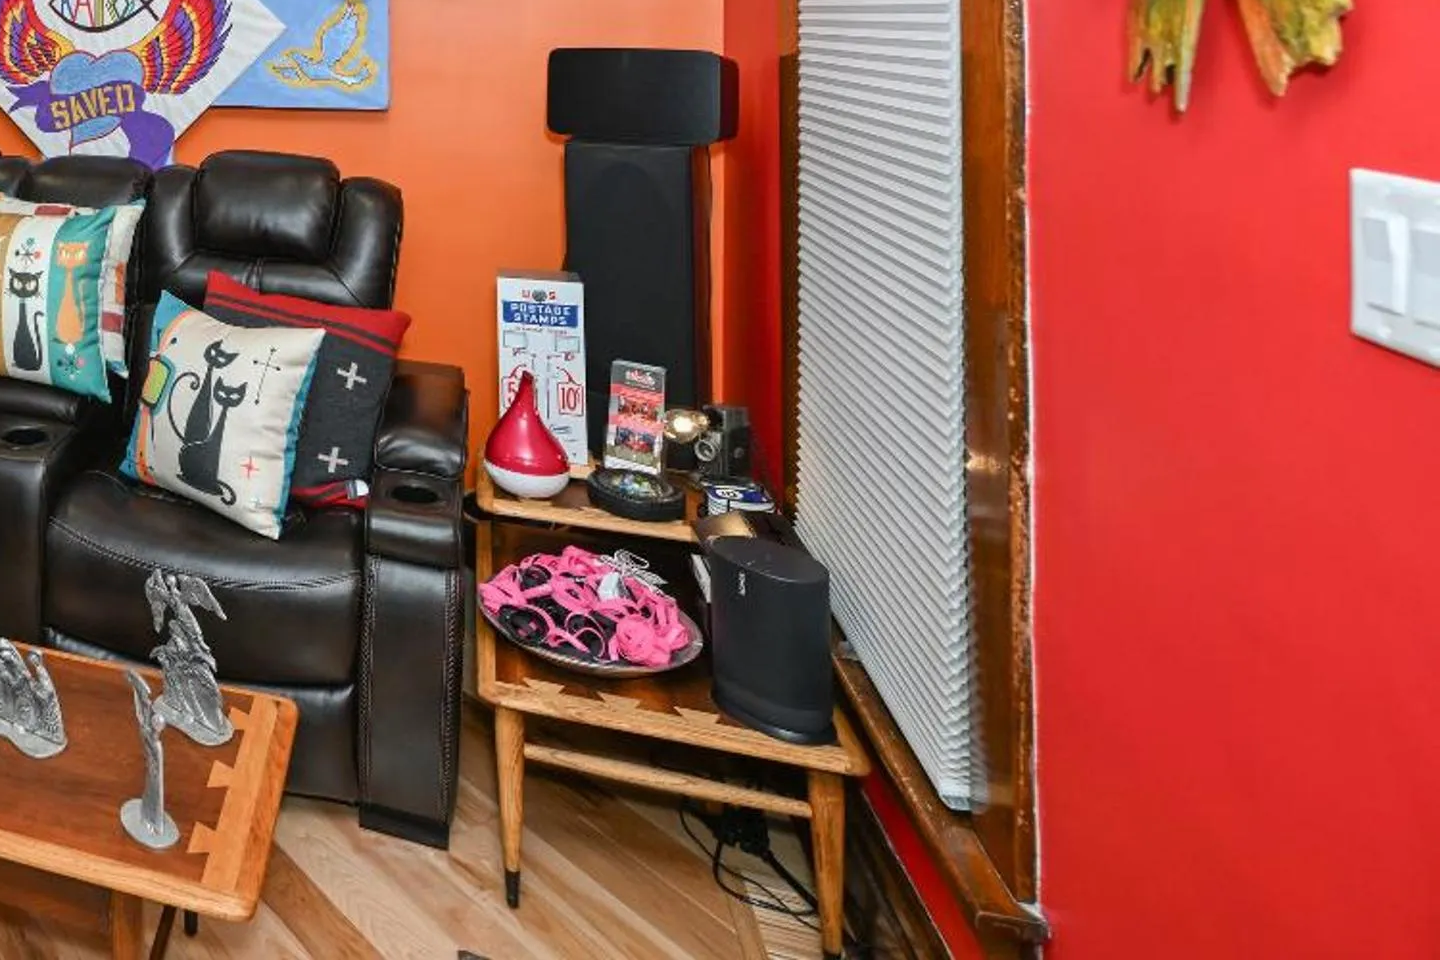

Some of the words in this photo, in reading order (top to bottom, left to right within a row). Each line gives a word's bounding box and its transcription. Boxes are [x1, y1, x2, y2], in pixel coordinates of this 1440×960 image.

[50, 84, 135, 130] SAVED
[510, 302, 571, 316] POSTAGE
[513, 312, 568, 326] STAMPS
